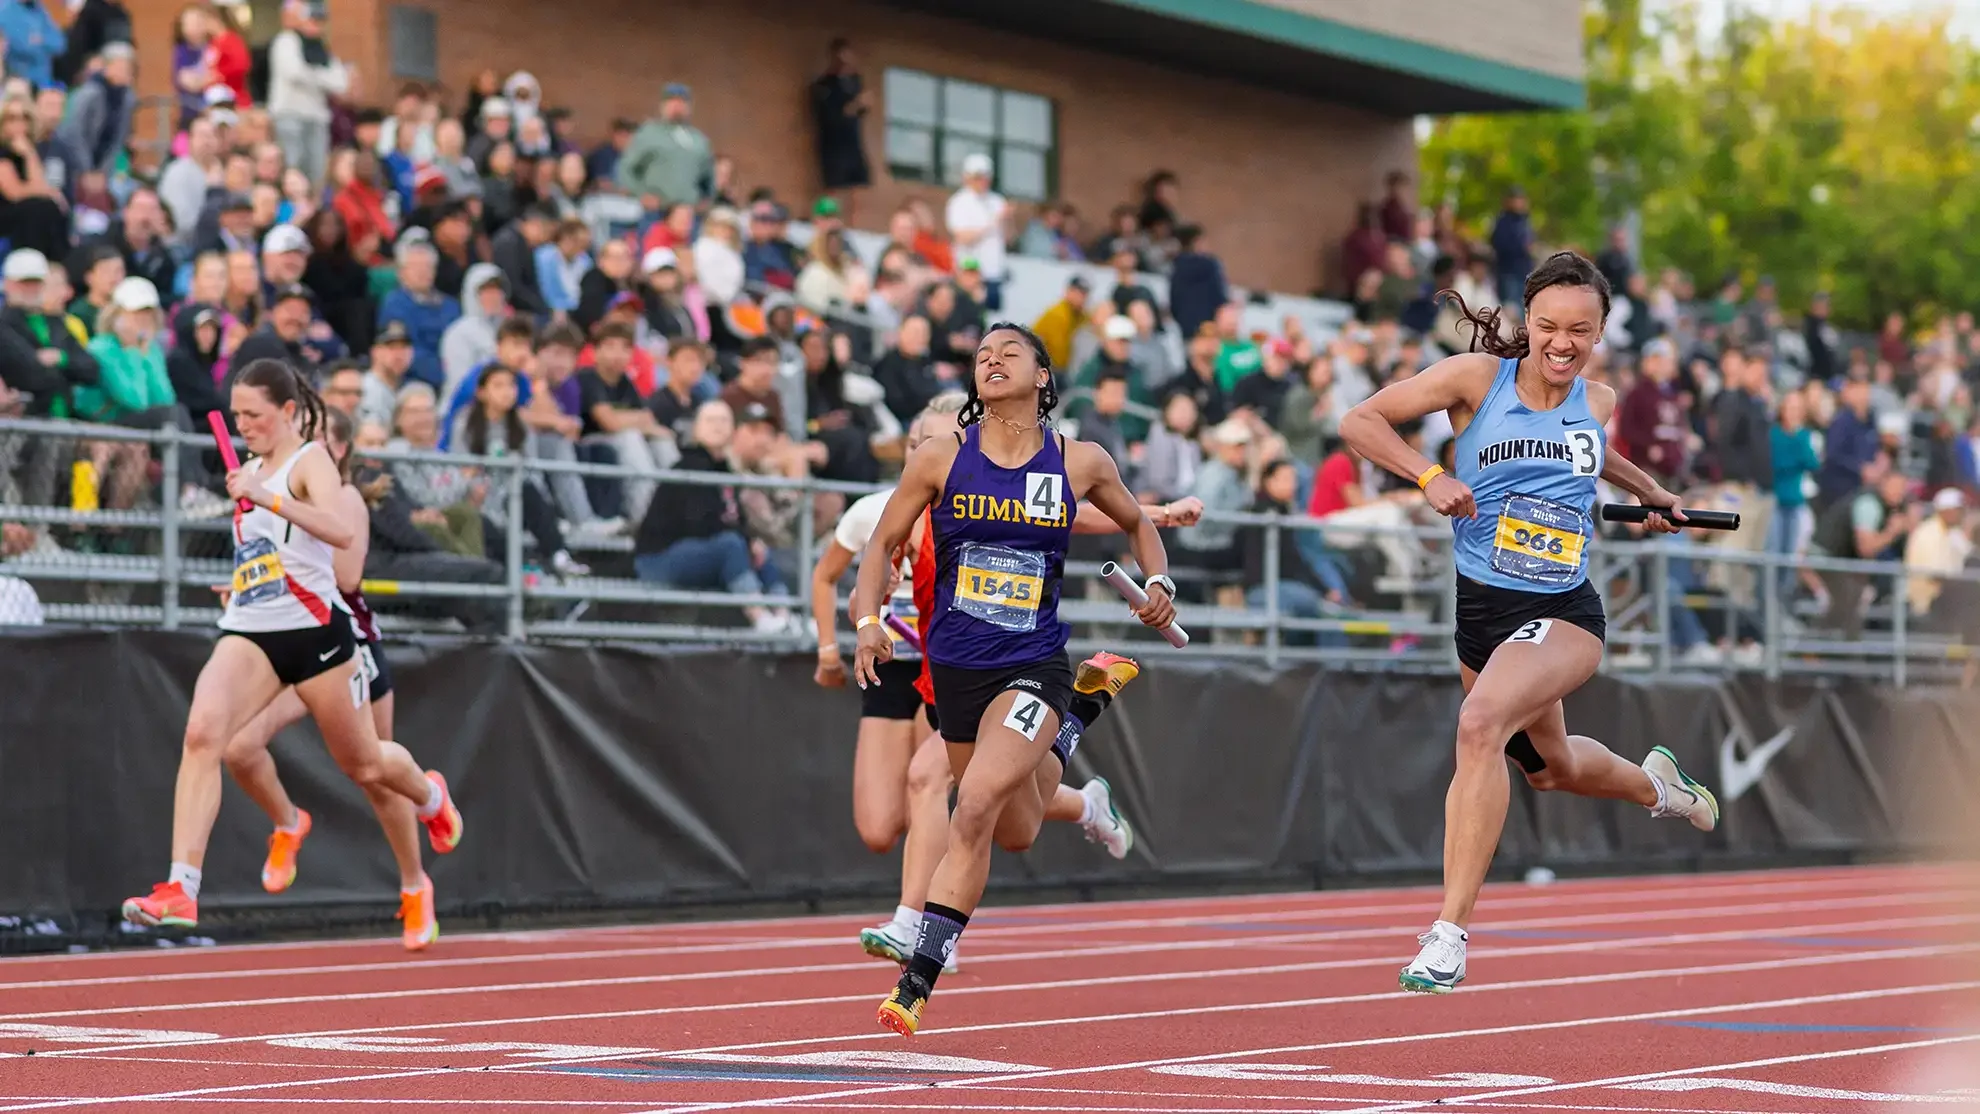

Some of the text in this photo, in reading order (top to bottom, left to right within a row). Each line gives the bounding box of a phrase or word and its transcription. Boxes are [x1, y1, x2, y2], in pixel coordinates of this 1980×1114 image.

[1478, 438, 1574, 472] MOUNTAINS
[1573, 432, 1597, 474] 3
[952, 494, 1068, 528] SUMNR
[1031, 476, 1056, 516] 4
[1514, 528, 1563, 555] 966
[971, 575, 1031, 601] 1545
[1512, 621, 1543, 641] 3
[1013, 700, 1041, 734] 4
